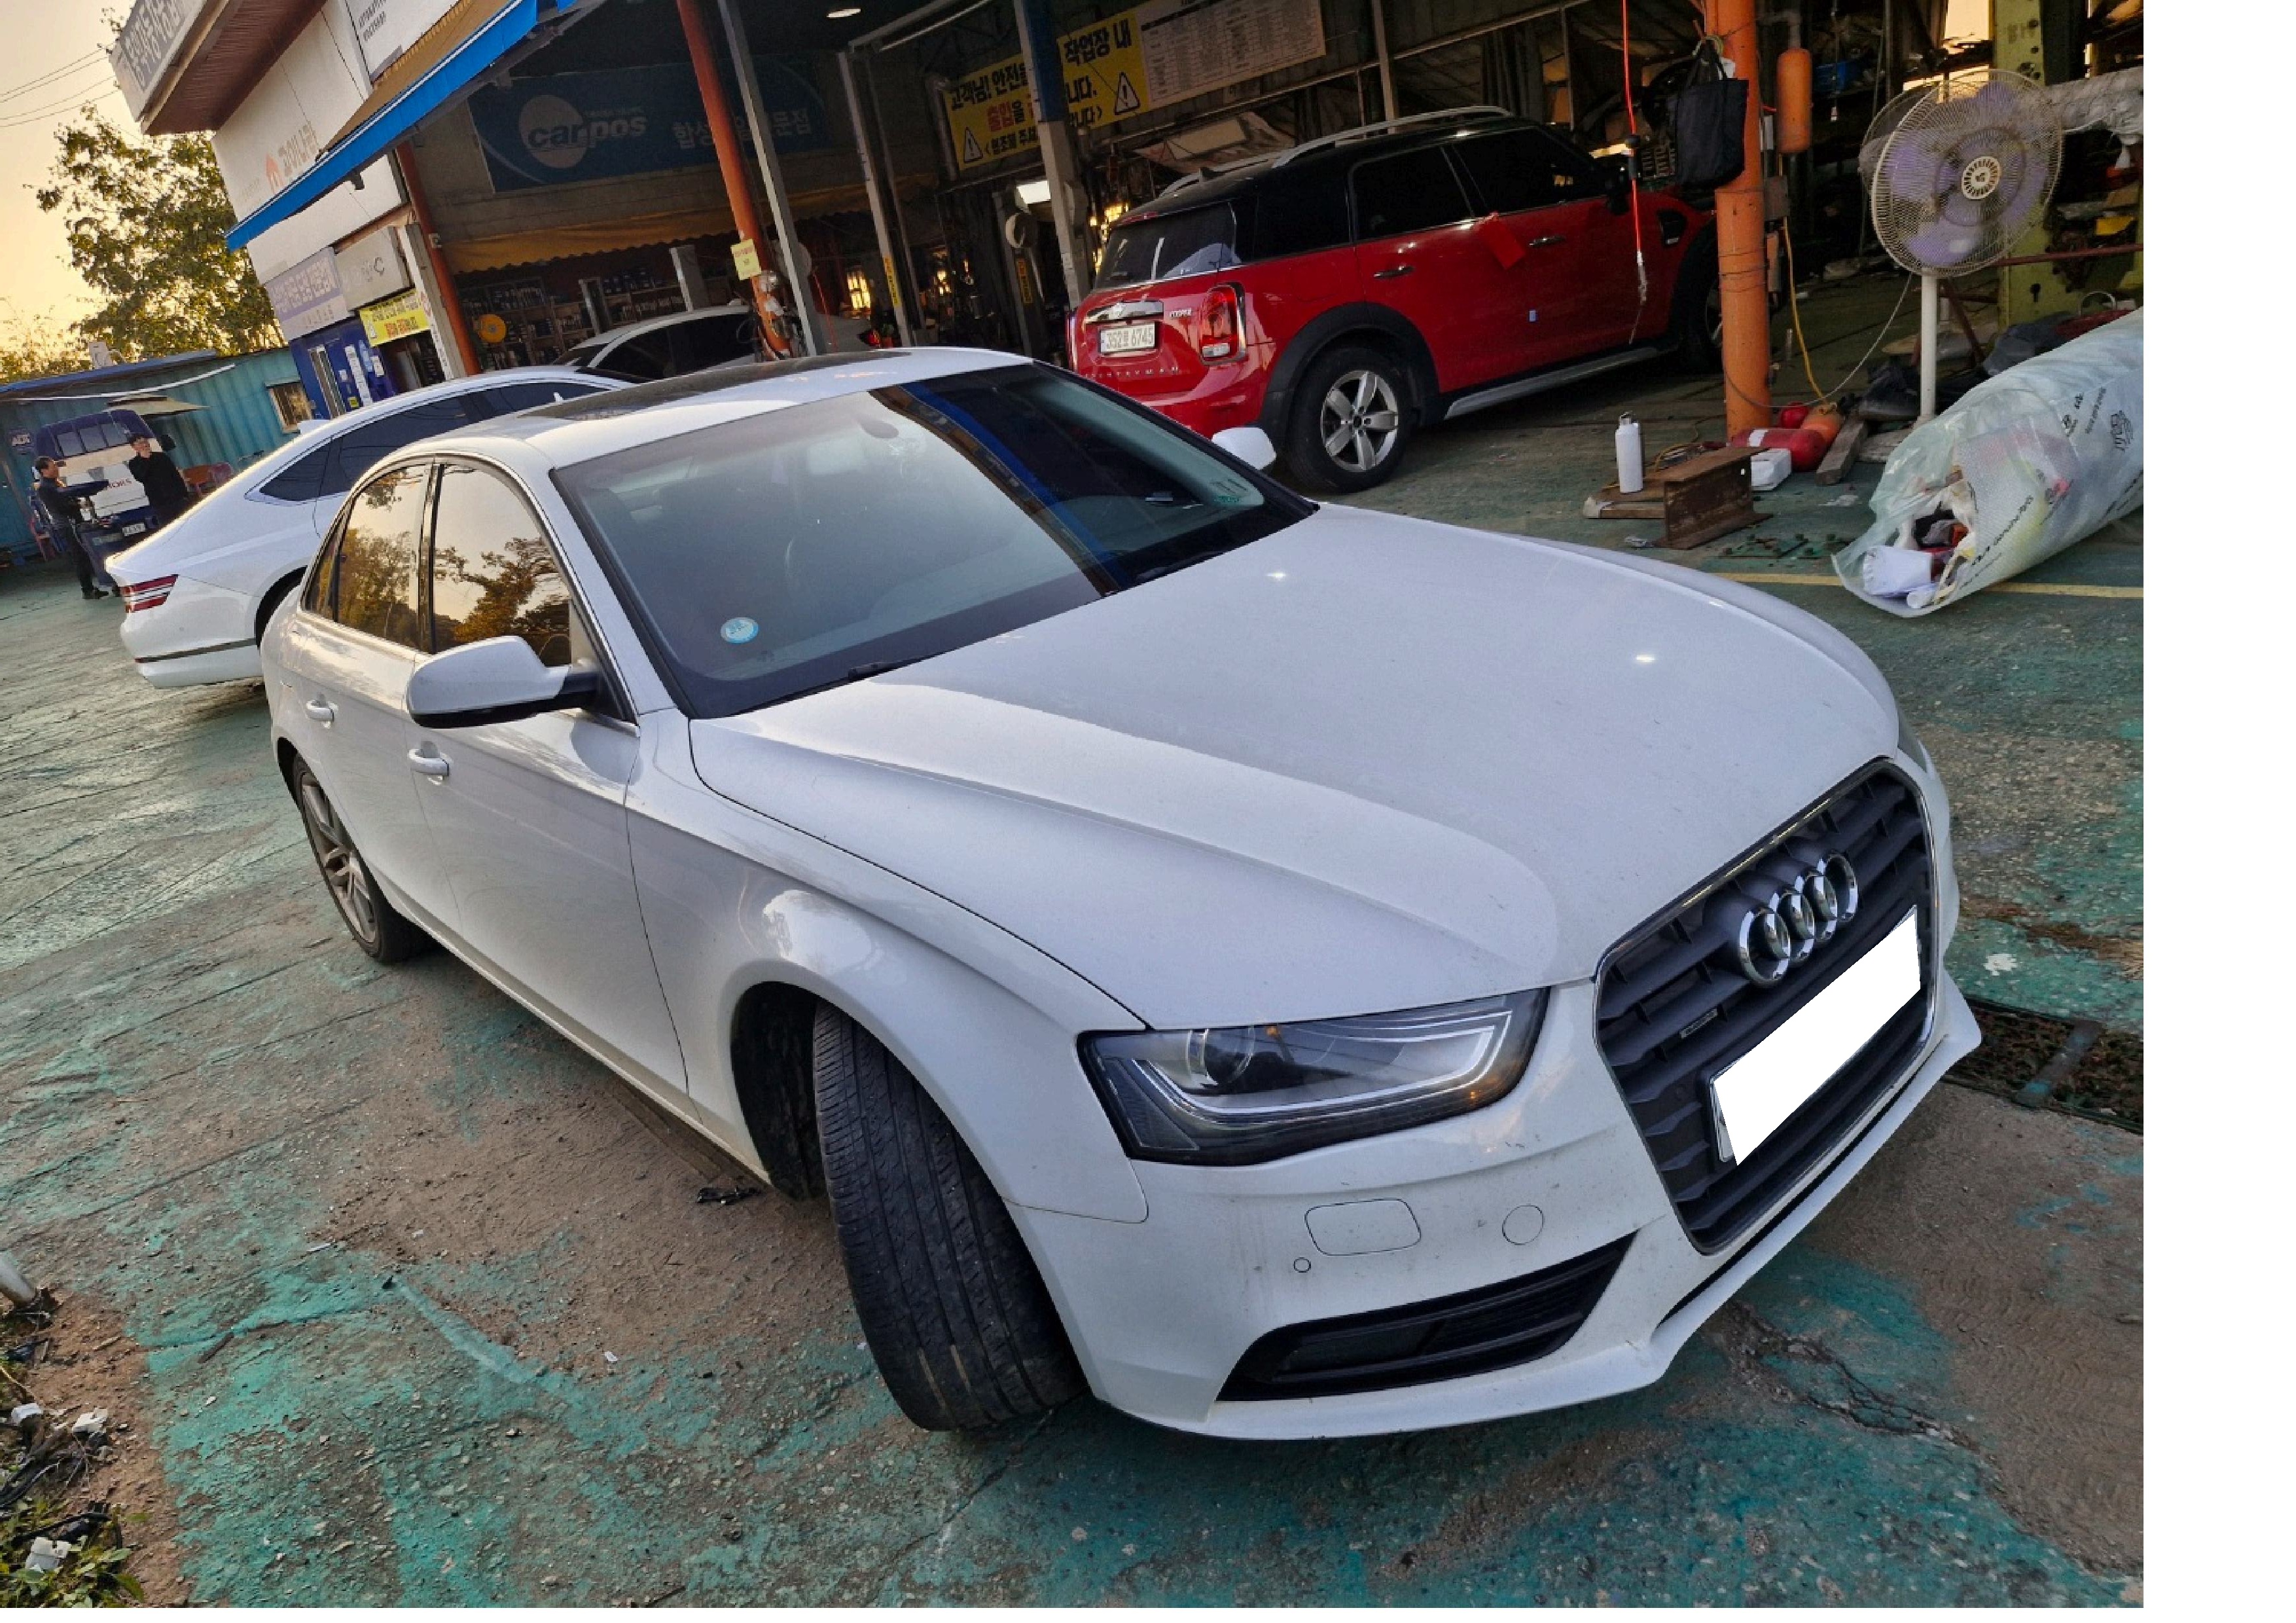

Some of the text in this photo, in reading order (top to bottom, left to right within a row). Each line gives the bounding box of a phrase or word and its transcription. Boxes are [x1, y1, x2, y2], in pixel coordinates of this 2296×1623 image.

[951, 75, 992, 111] 고객님!
[1063, 27, 1111, 66] 작업장
[1113, 18, 1132, 48] 내
